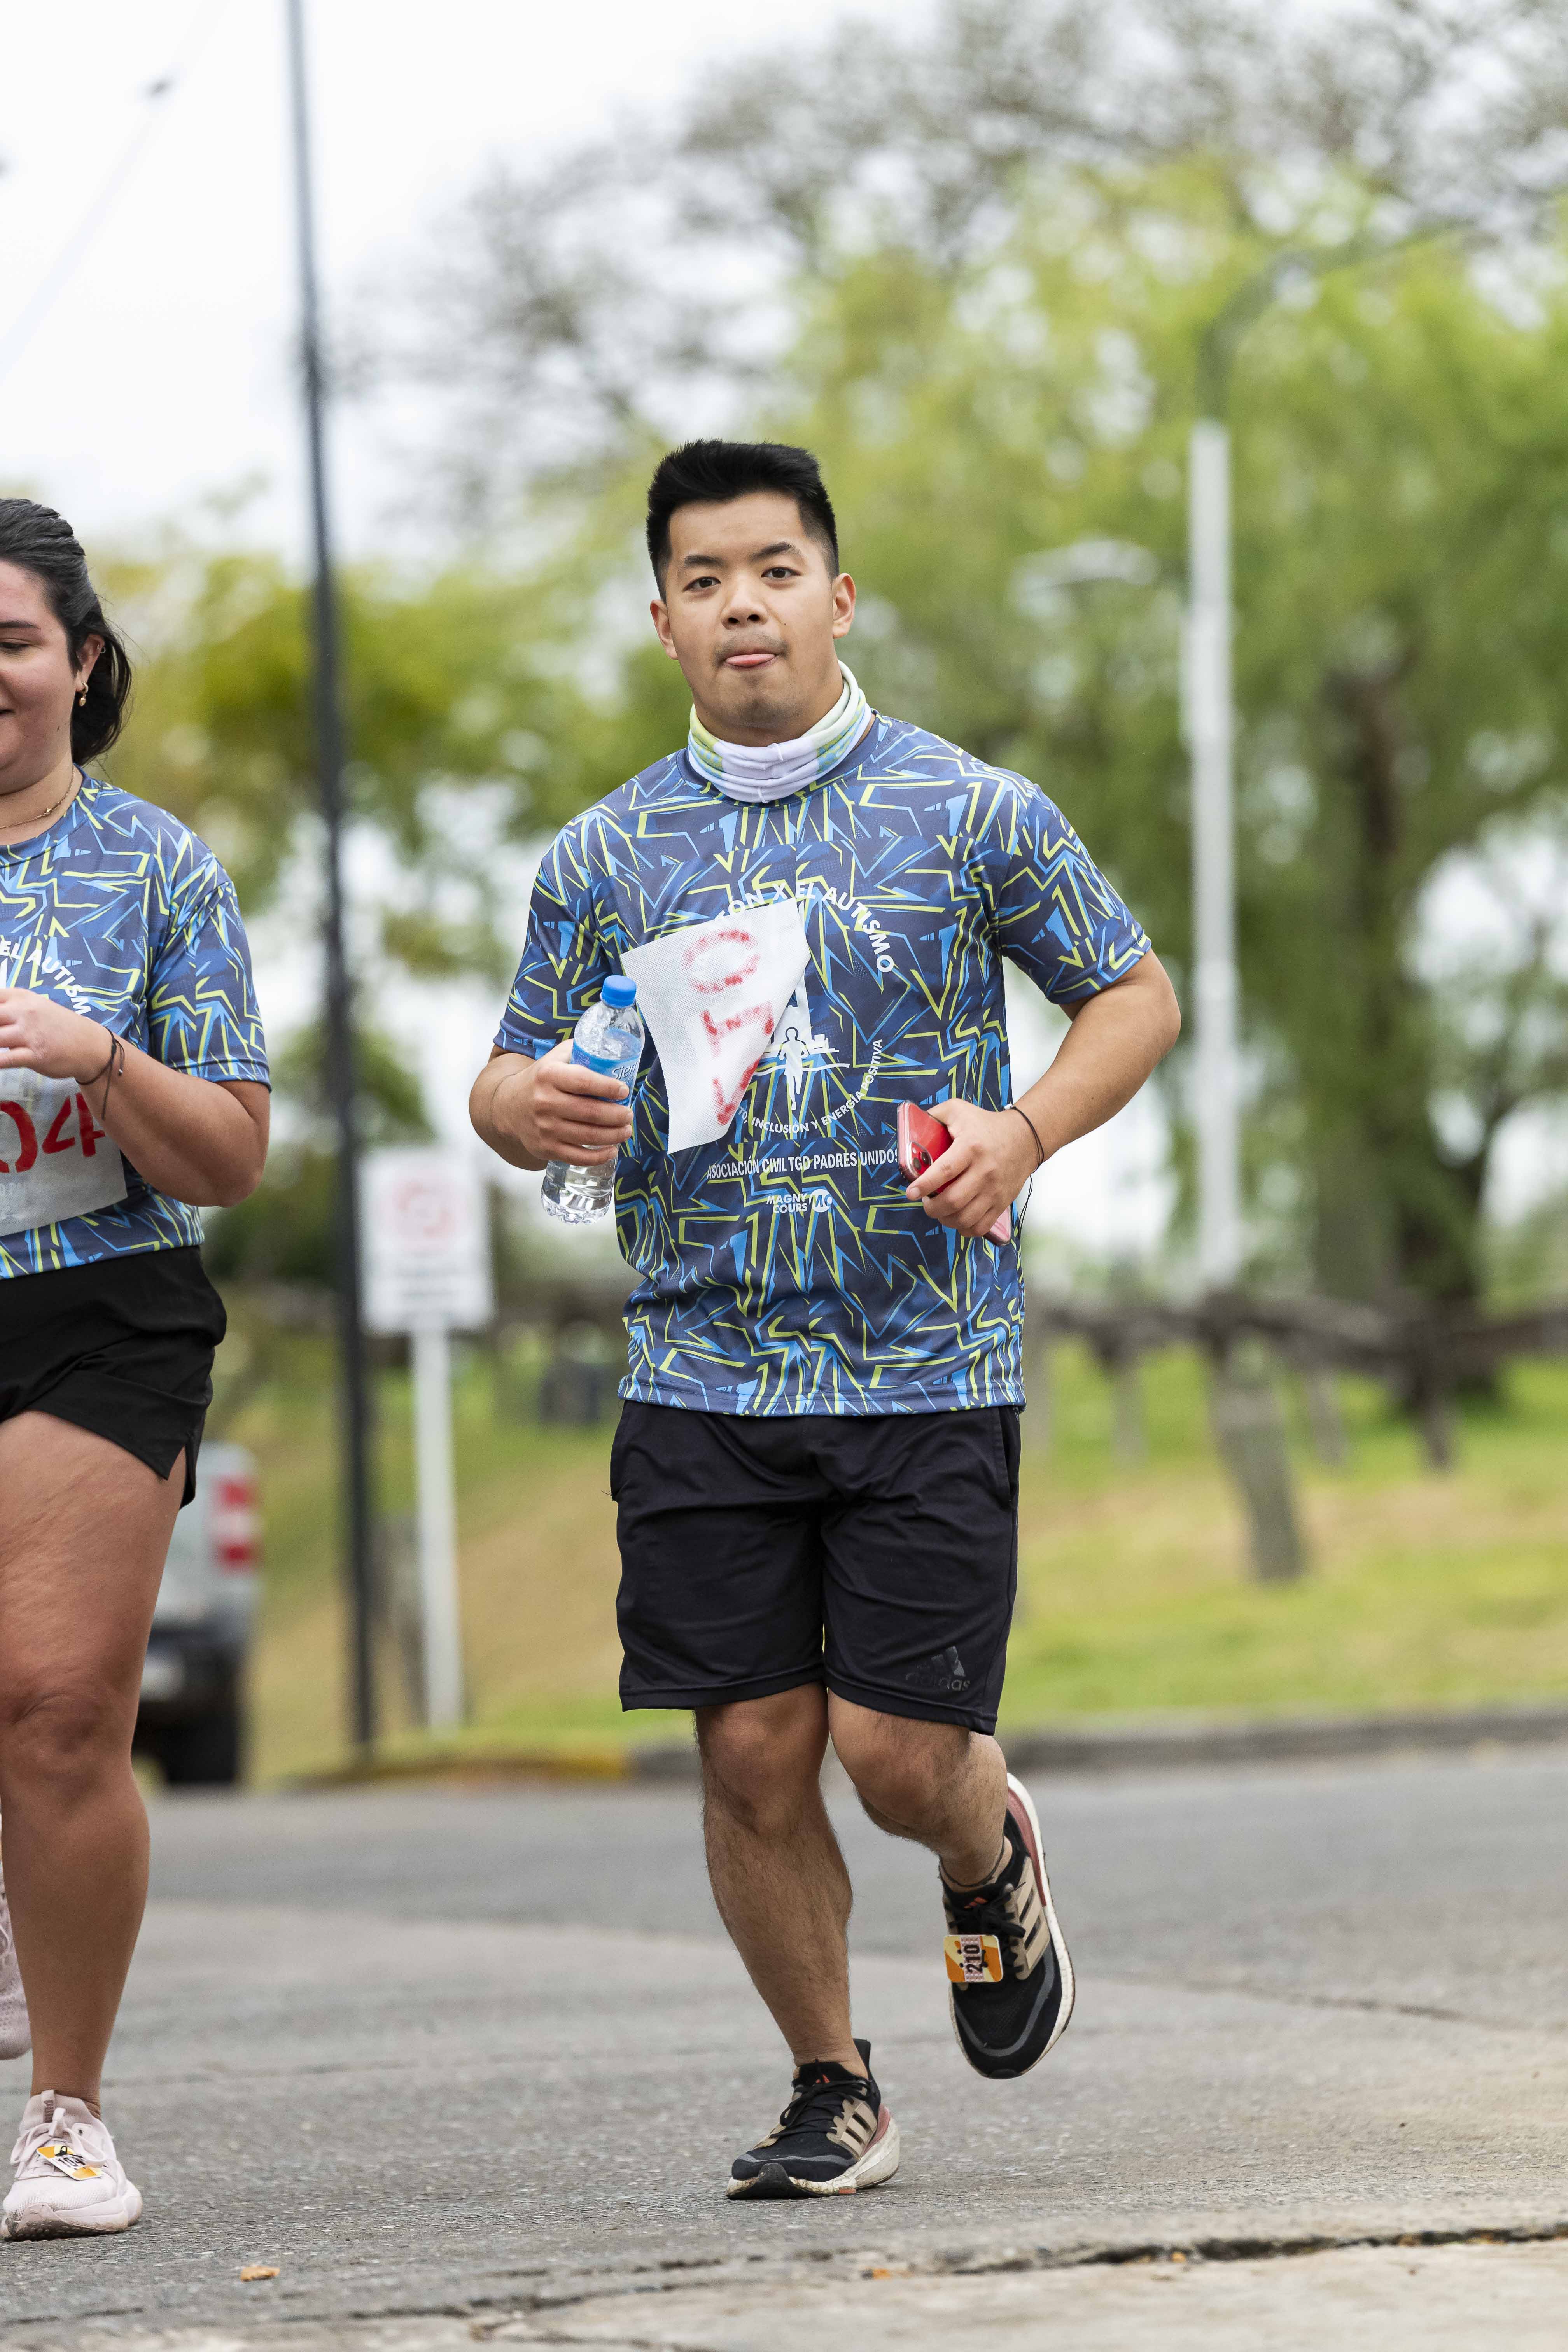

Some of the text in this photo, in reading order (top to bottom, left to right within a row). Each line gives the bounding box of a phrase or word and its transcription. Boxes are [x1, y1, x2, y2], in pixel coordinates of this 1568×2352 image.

[772, 883, 788, 900] X
[796, 882, 816, 899] EL
[821, 887, 894, 973] AUTISMO
[0, 940, 21, 960] EL
[751, 1117, 809, 1134] INCLUSIÓN
[810, 1119, 818, 1129] Y
[821, 1091, 863, 1126] ENERGÍA
[861, 1039, 883, 1091] POSITIVA
[707, 1155, 760, 1179] ASOCIACIÓN
[762, 1157, 787, 1172] CIVIL
[788, 1155, 810, 1171] TGD
[814, 1151, 857, 1169] PADRES
[766, 1193, 807, 1205] MAGNY
[773, 1203, 808, 1214] COURS
[963, 1944, 983, 1973] 210
